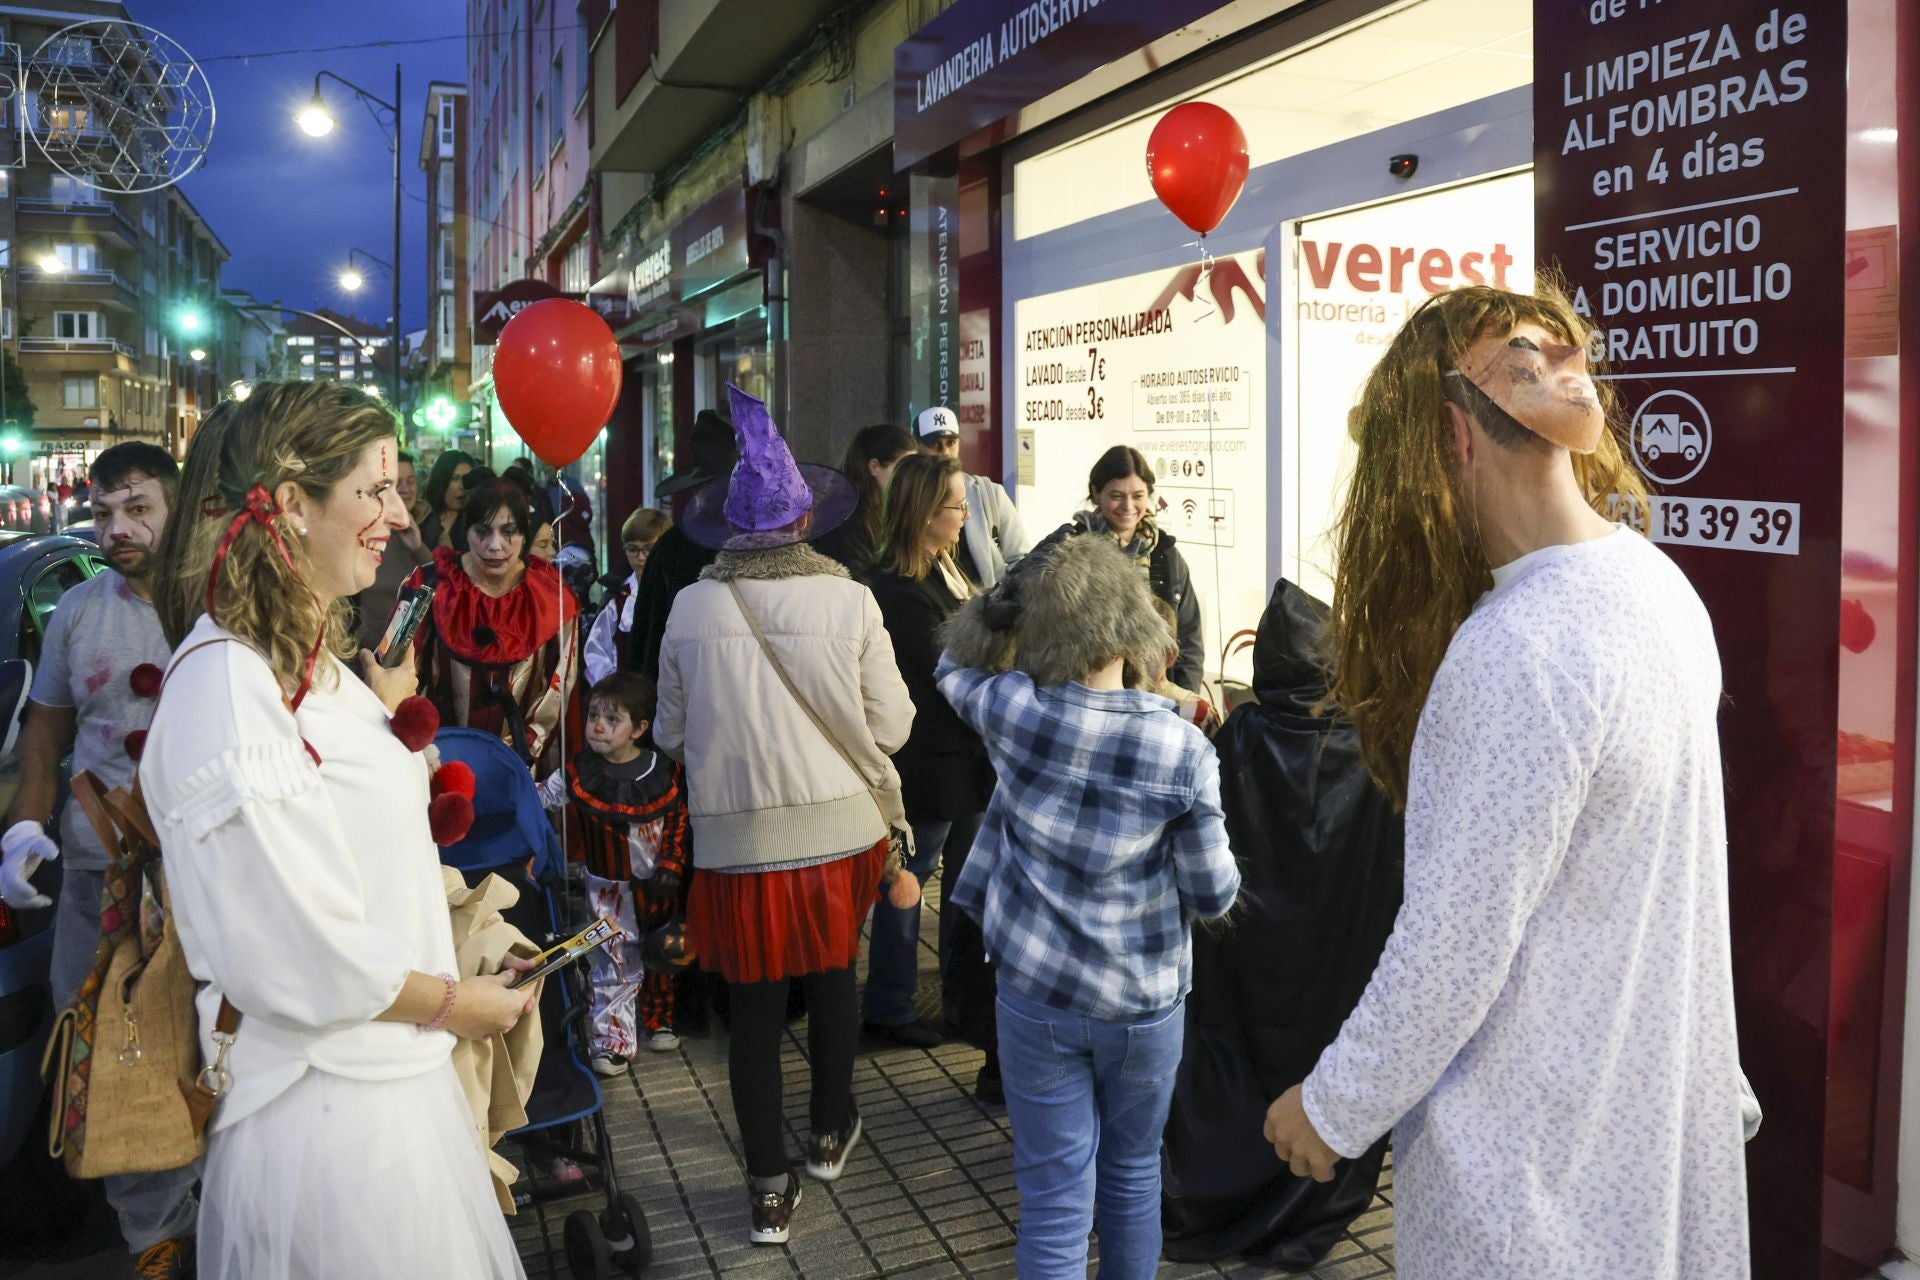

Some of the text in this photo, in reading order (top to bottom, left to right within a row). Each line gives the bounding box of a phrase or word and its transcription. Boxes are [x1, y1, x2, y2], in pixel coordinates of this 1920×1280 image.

[917, 32, 994, 113] LAVANDERIA
[1563, 8, 1808, 107] LIMPIEZA de
[1561, 59, 1809, 156] ALFOMBRAS
[1592, 130, 1765, 198] en 4 días
[938, 206, 949, 314] ATENCIÓN
[1300, 240, 1513, 293] verest
[1593, 214, 1761, 271] SERVICIO
[1296, 298, 1386, 323] ntorería
[1572, 261, 1792, 318] A DOMICILIO
[1026, 308, 1173, 352] ATENCIÓN PERSONALIZADA
[1587, 317, 1759, 363] GRATUITO
[1026, 362, 1063, 387] LAVADO
[1065, 365, 1087, 383] desde
[1141, 366, 1240, 388] HORARIO AUTOSERVICIO
[1026, 399, 1063, 421] SECADO
[1065, 404, 1087, 420] desde
[1660, 502, 1690, 538] 13
[1699, 504, 1740, 542] 39
[1749, 507, 1793, 546] 39
